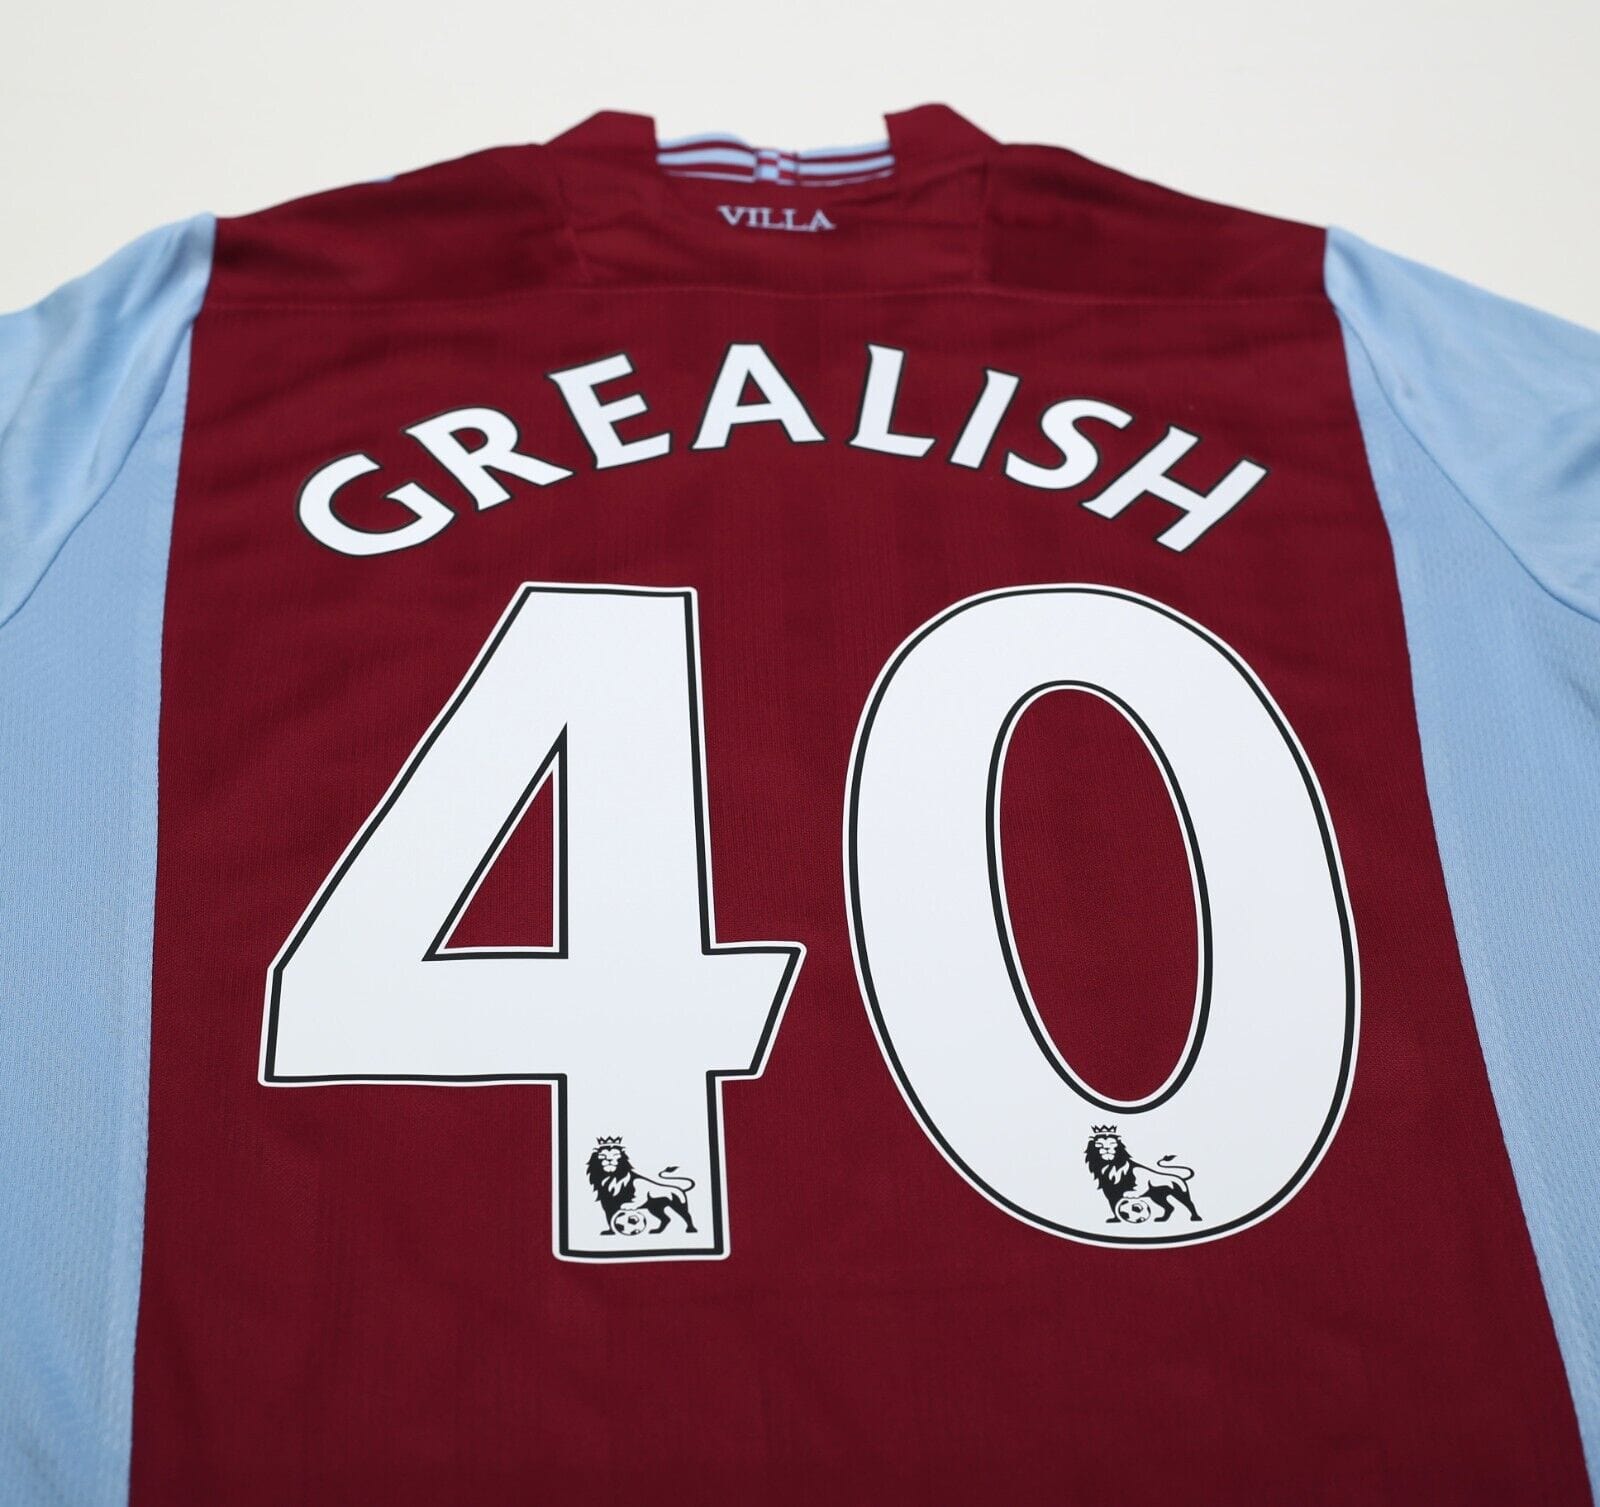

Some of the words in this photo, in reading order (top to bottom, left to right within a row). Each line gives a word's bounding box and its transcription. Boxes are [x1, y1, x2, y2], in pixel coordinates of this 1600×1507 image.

[717, 204, 836, 233] VILLA
[296, 342, 1268, 556] GREALISH
[258, 581, 1361, 1264] 40
